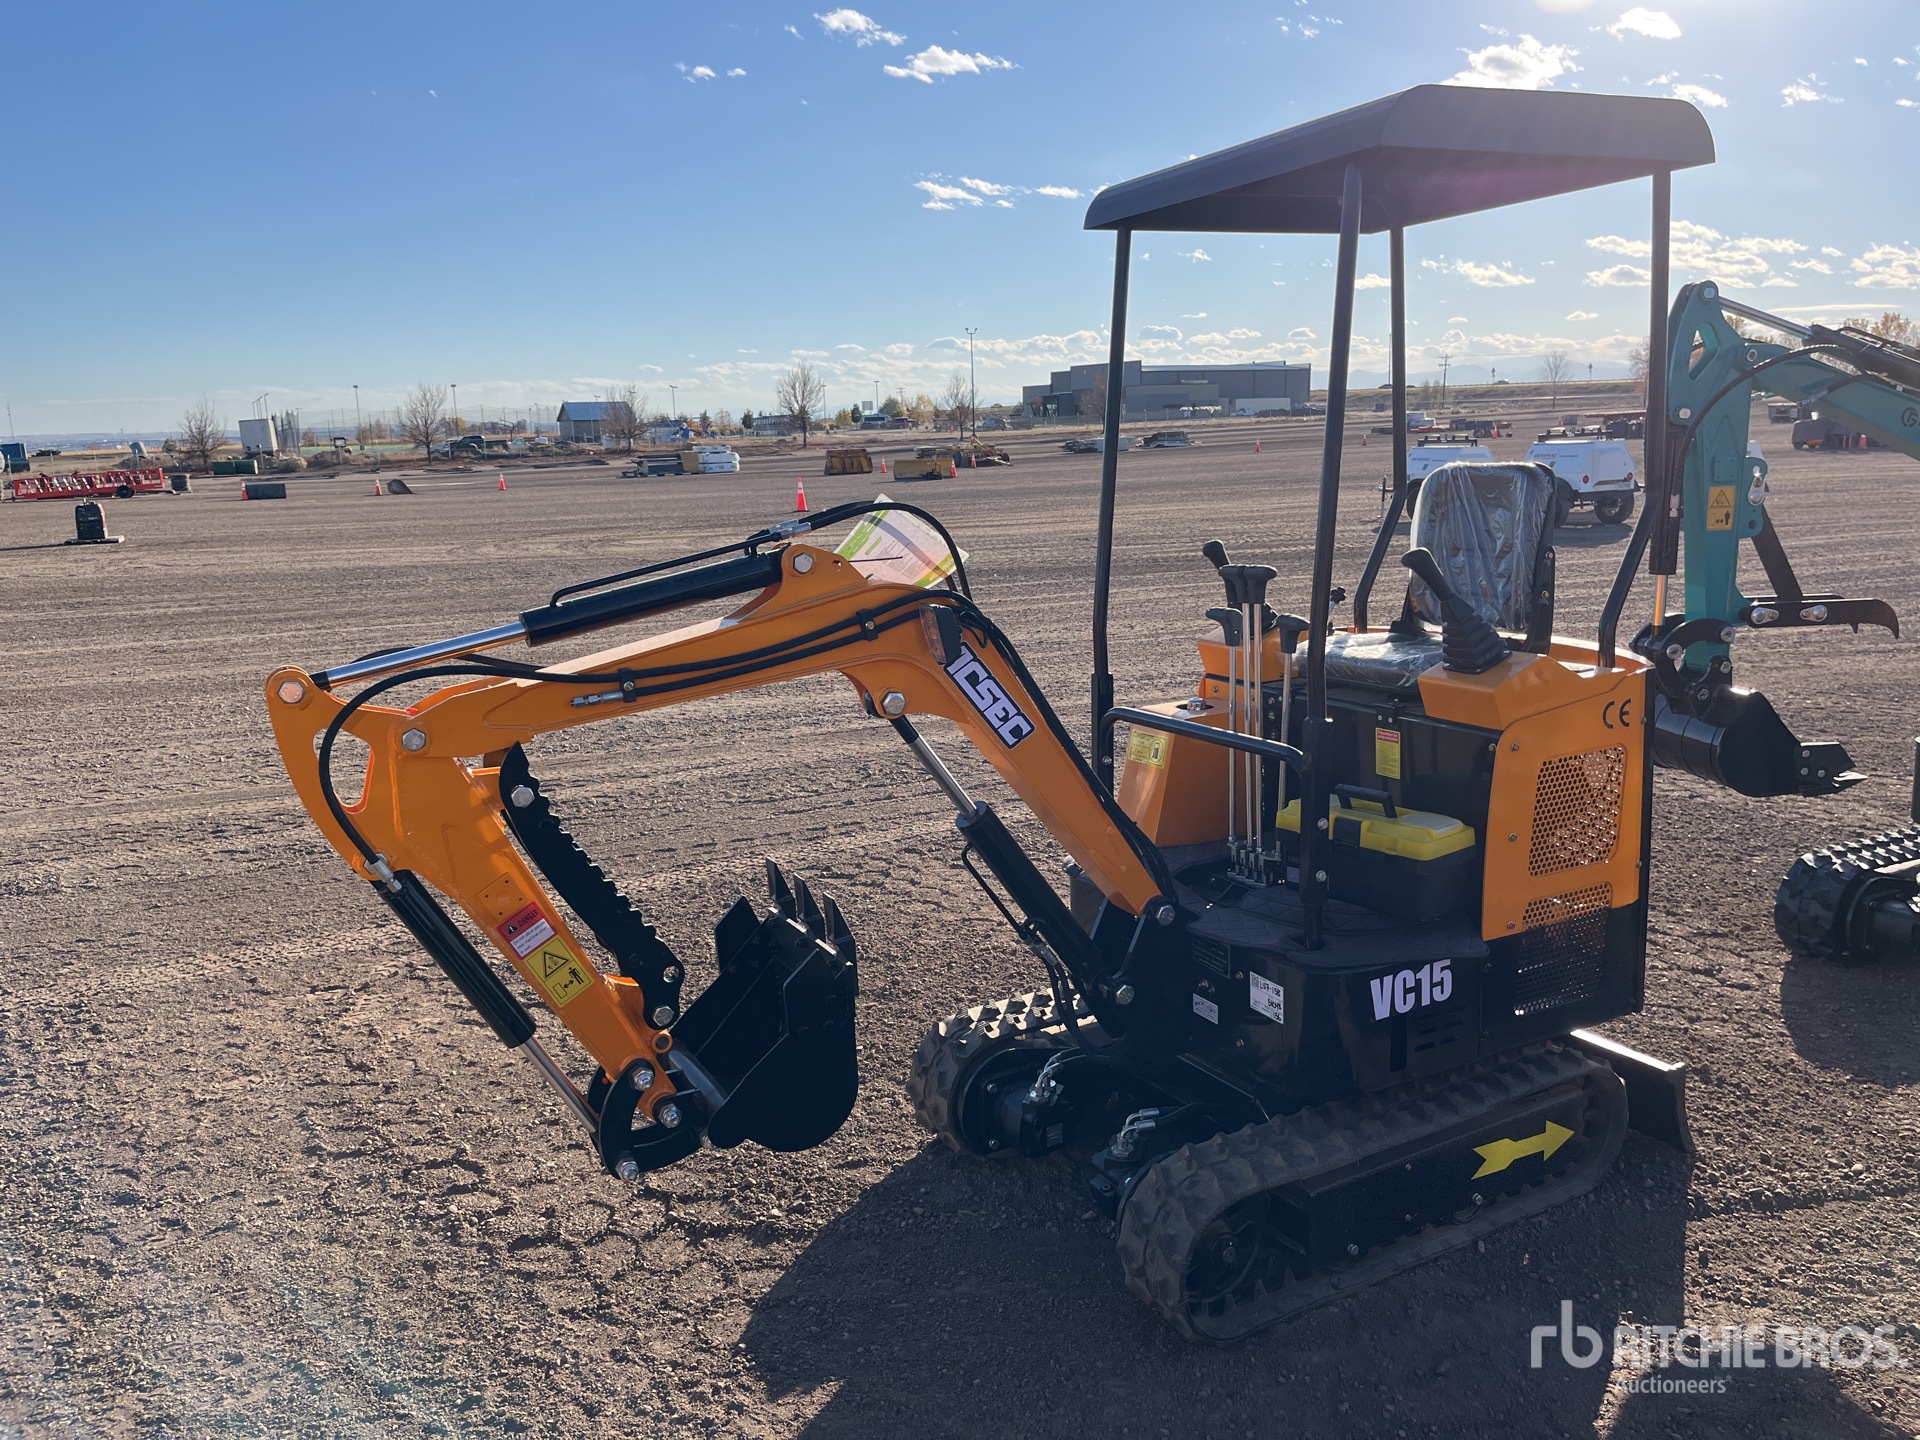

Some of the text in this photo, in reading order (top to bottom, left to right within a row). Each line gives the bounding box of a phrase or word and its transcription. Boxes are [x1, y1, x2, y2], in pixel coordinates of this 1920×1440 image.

[1602, 698, 1631, 729] CE
[517, 909, 539, 927] DANGER
[1370, 959, 1452, 1021] VC15
